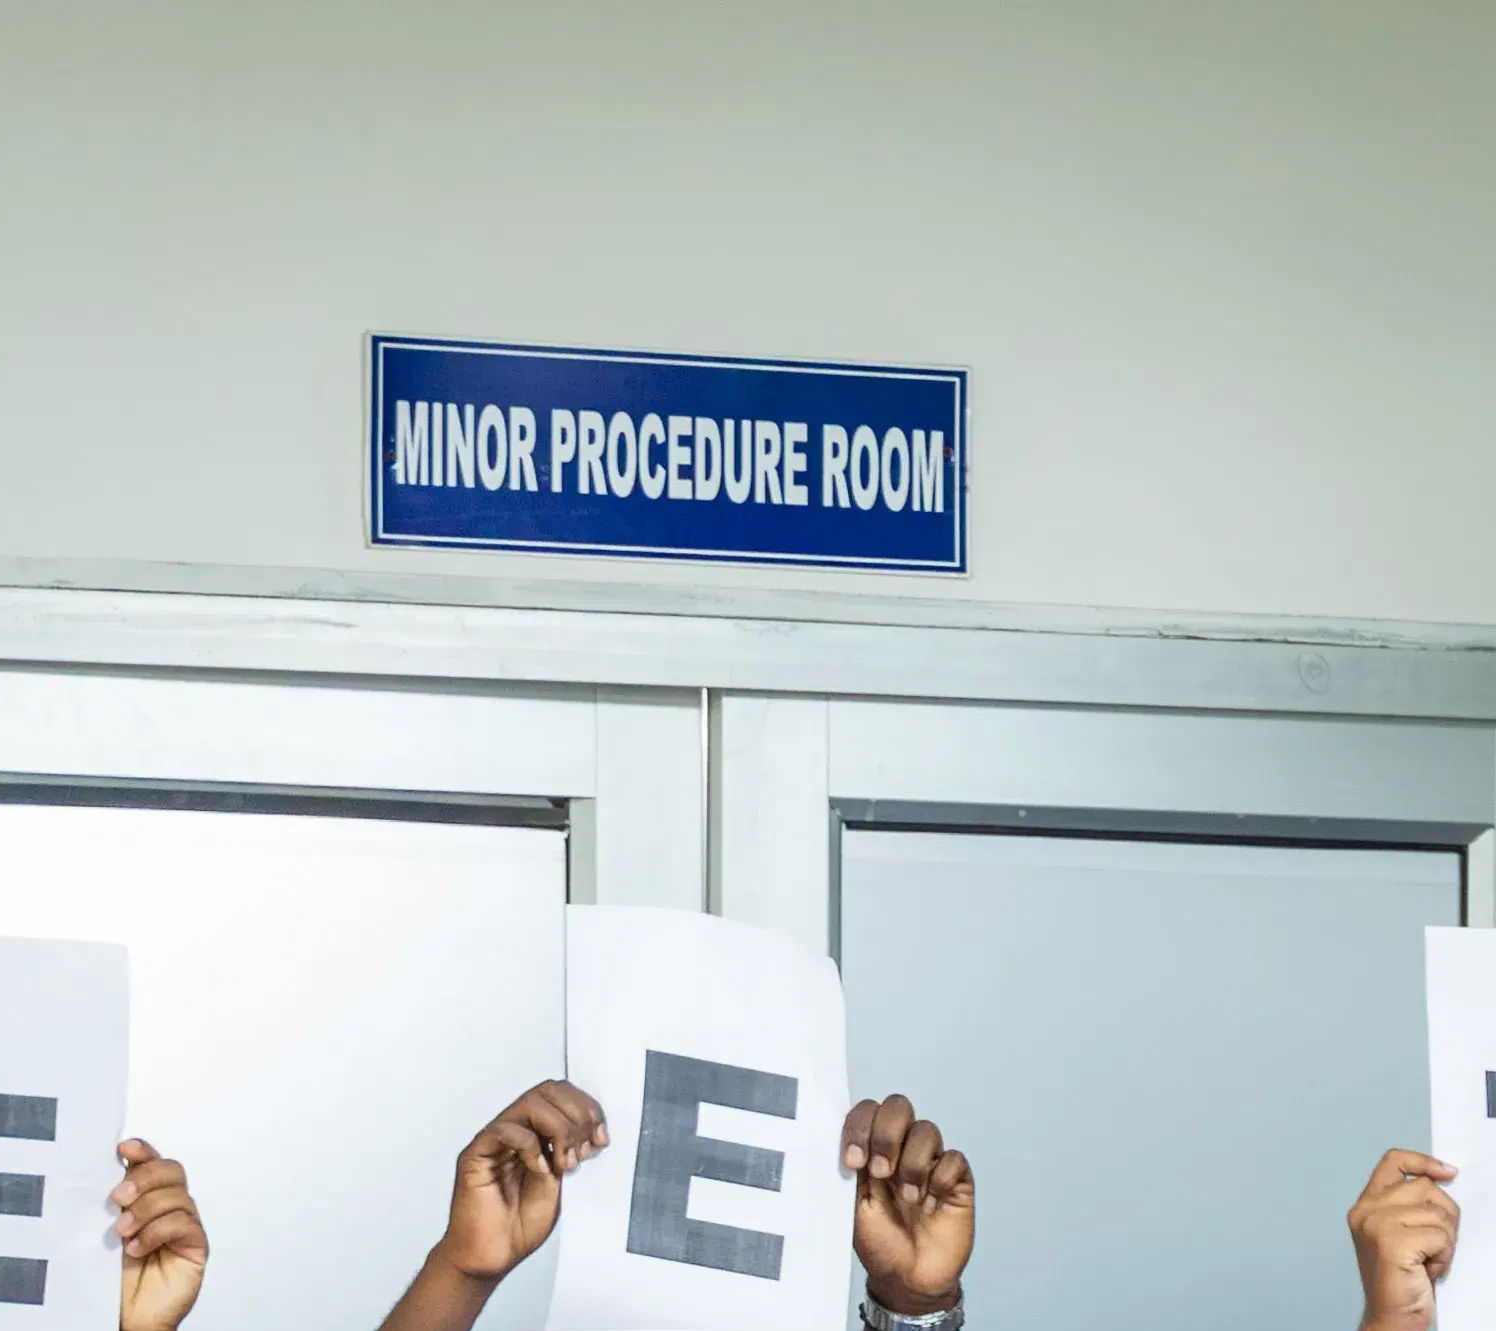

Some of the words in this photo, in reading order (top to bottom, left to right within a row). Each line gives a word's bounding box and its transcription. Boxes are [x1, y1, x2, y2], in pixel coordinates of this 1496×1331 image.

[395, 400, 539, 492] MINOR
[550, 408, 808, 506] PROCEDURE
[822, 424, 945, 513] ROOM
[626, 1049, 798, 1281] E
